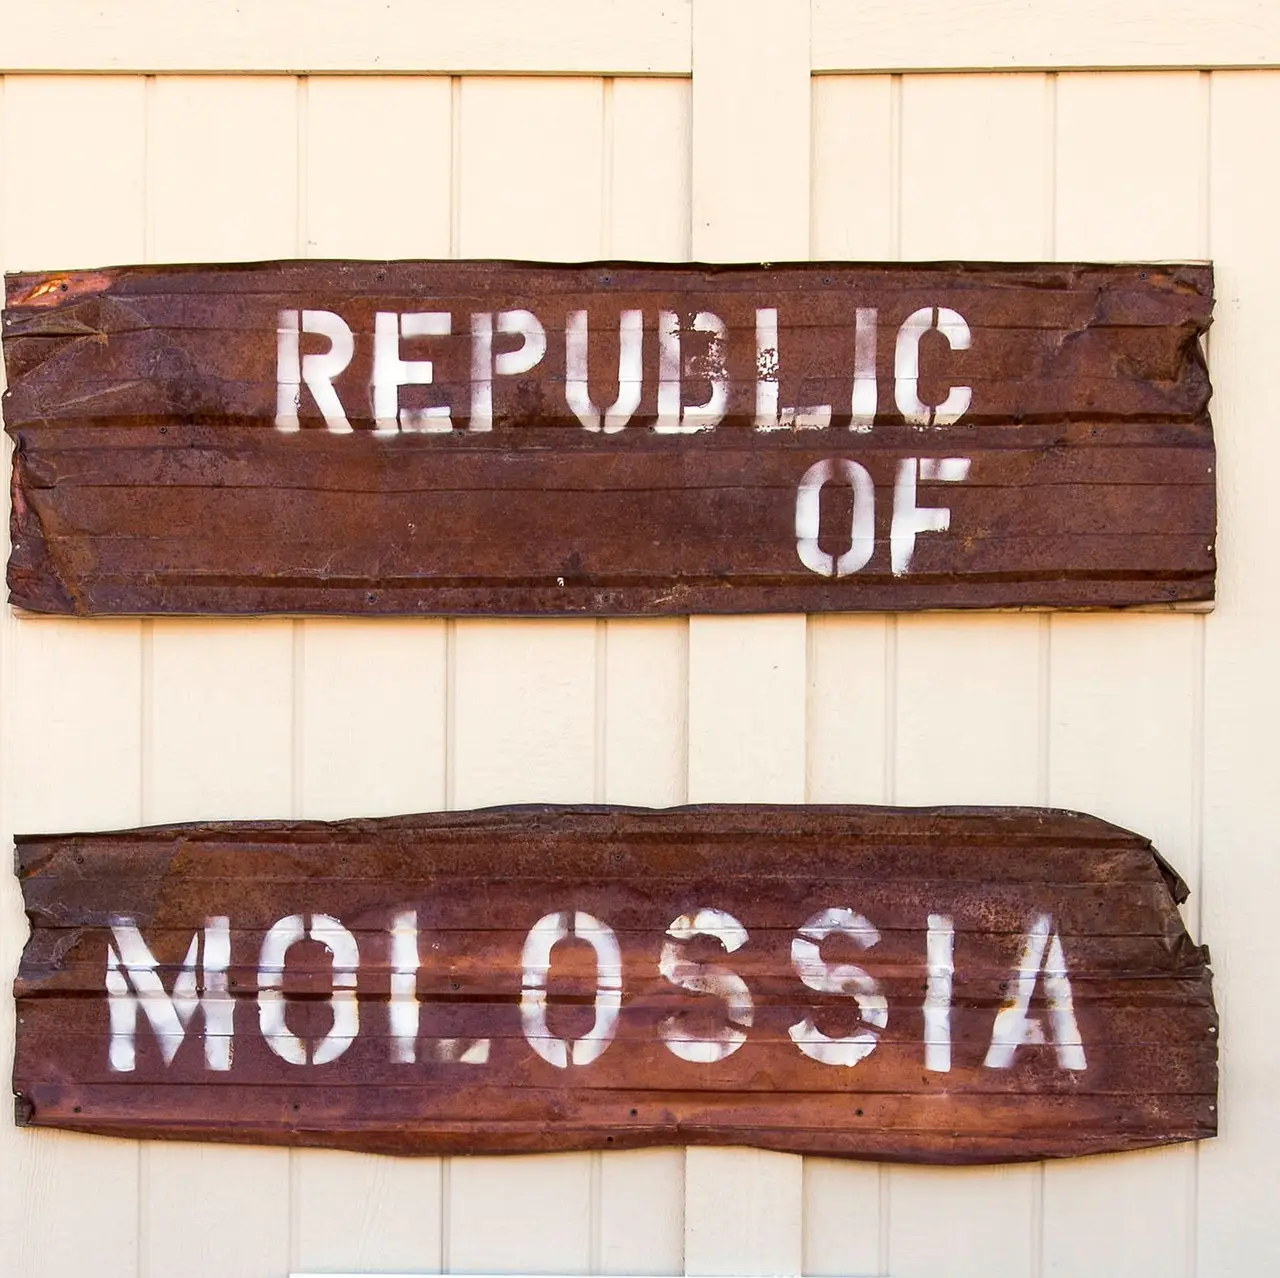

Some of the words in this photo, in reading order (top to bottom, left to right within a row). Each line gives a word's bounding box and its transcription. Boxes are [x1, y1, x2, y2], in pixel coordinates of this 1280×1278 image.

[275, 307, 973, 436] REPUBLIC
[794, 456, 973, 577] OF
[104, 906, 1091, 1073] MOLOSSIA
